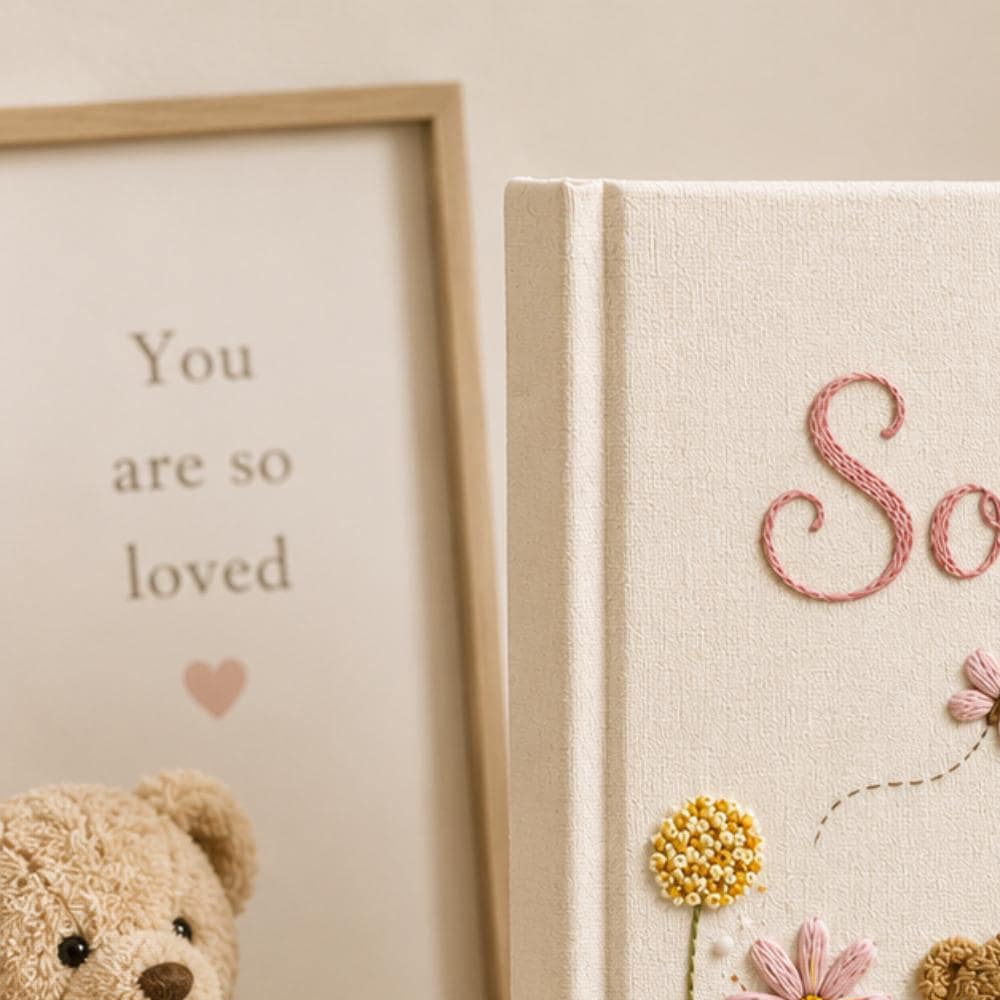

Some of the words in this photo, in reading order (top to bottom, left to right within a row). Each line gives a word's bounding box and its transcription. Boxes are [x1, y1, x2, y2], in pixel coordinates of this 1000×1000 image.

[130, 329, 253, 386] You
[112, 453, 205, 493] are
[229, 448, 293, 486] so
[126, 534, 291, 600] loved
